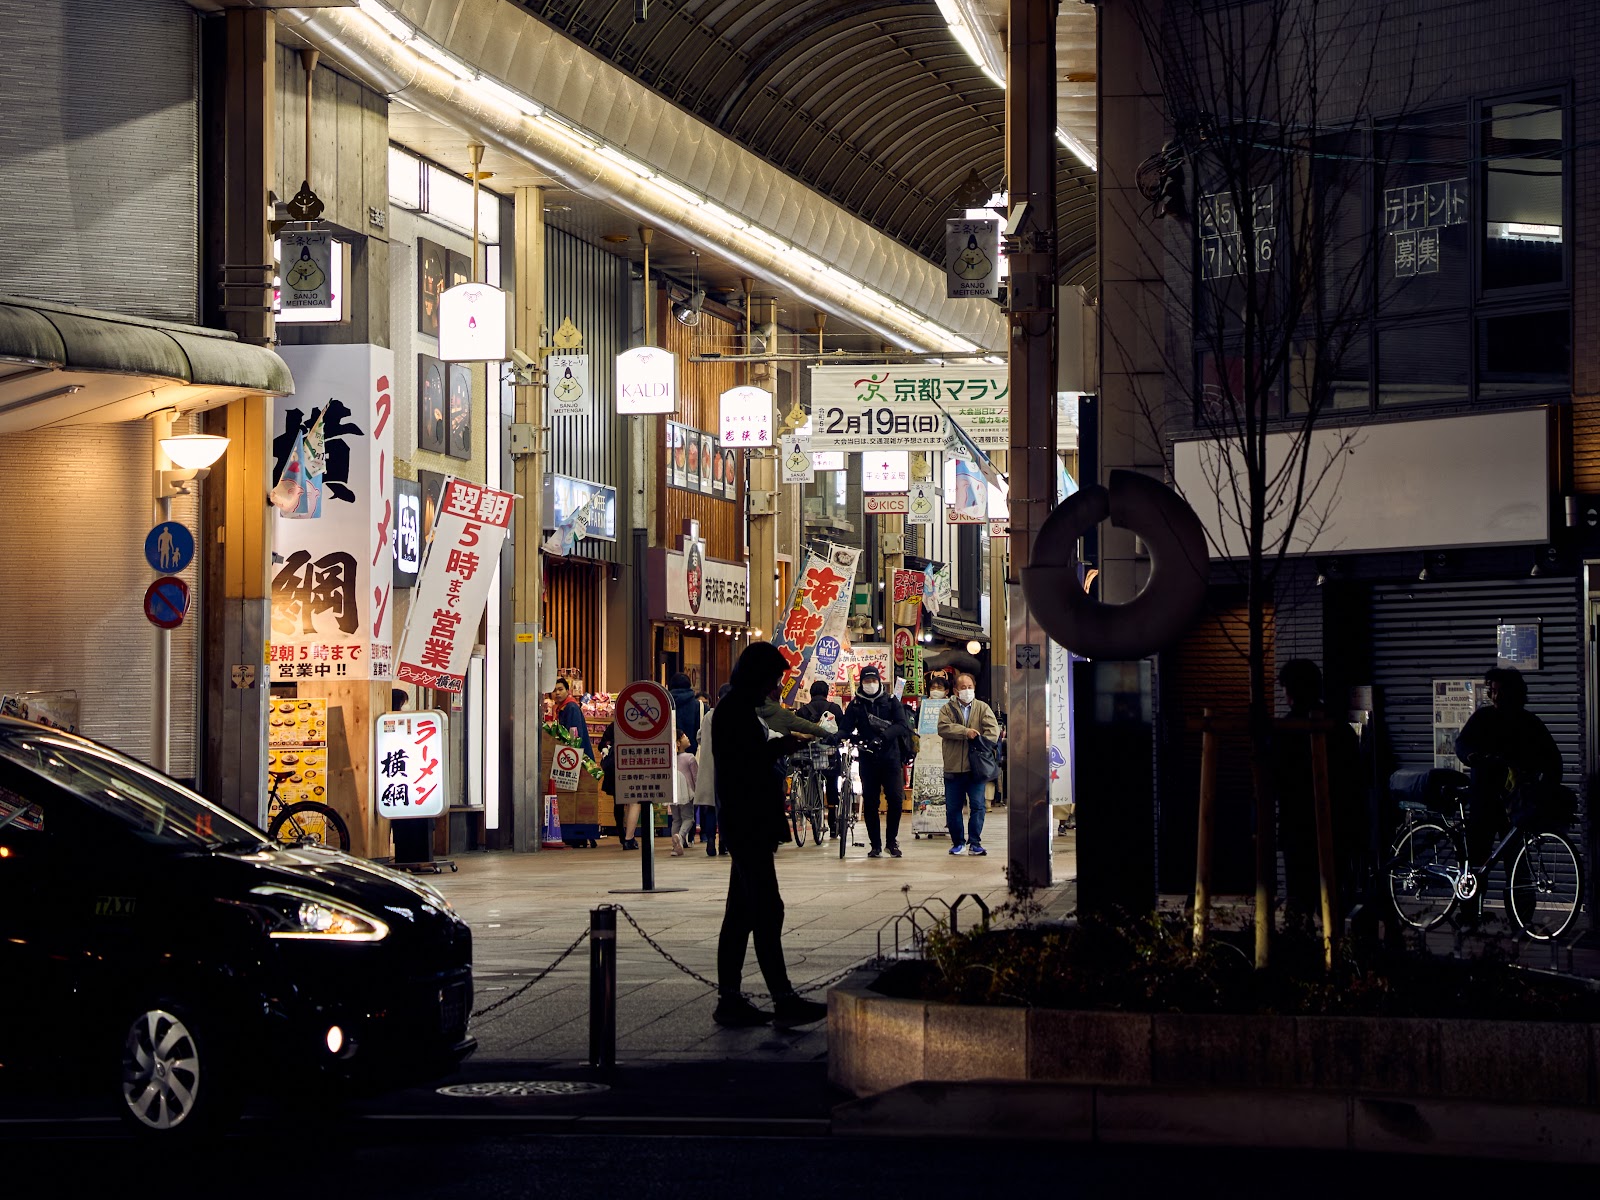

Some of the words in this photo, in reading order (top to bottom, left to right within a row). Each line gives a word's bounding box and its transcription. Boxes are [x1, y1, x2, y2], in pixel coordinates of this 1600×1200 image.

[1386, 188, 1465, 224] テナント
[1397, 236, 1437, 269] 募集
[293, 292, 318, 300] SANJO
[621, 382, 669, 398] KALDI
[893, 378, 1008, 402] 京都マラソ
[826, 407, 939, 435] 2月19日(日)
[725, 429, 768, 441] 若狭家
[374, 375, 392, 638] ラーメン
[447, 482, 511, 525] 翌朝
[879, 500, 905, 510] KICS
[420, 523, 482, 670] 5時まで営業
[705, 576, 746, 607] 若狭家三条店
[270, 645, 362, 661] 翌朝5時まで
[819, 639, 839, 649] ハズレ
[905, 648, 915, 694] 処方箋
[414, 720, 438, 805] ラーメン
[621, 747, 666, 756] 自転車通行は
[621, 757, 666, 766] 終日通行禁止
[380, 748, 410, 808] 横綱
[552, 769, 578, 779] 駐輪禁止
